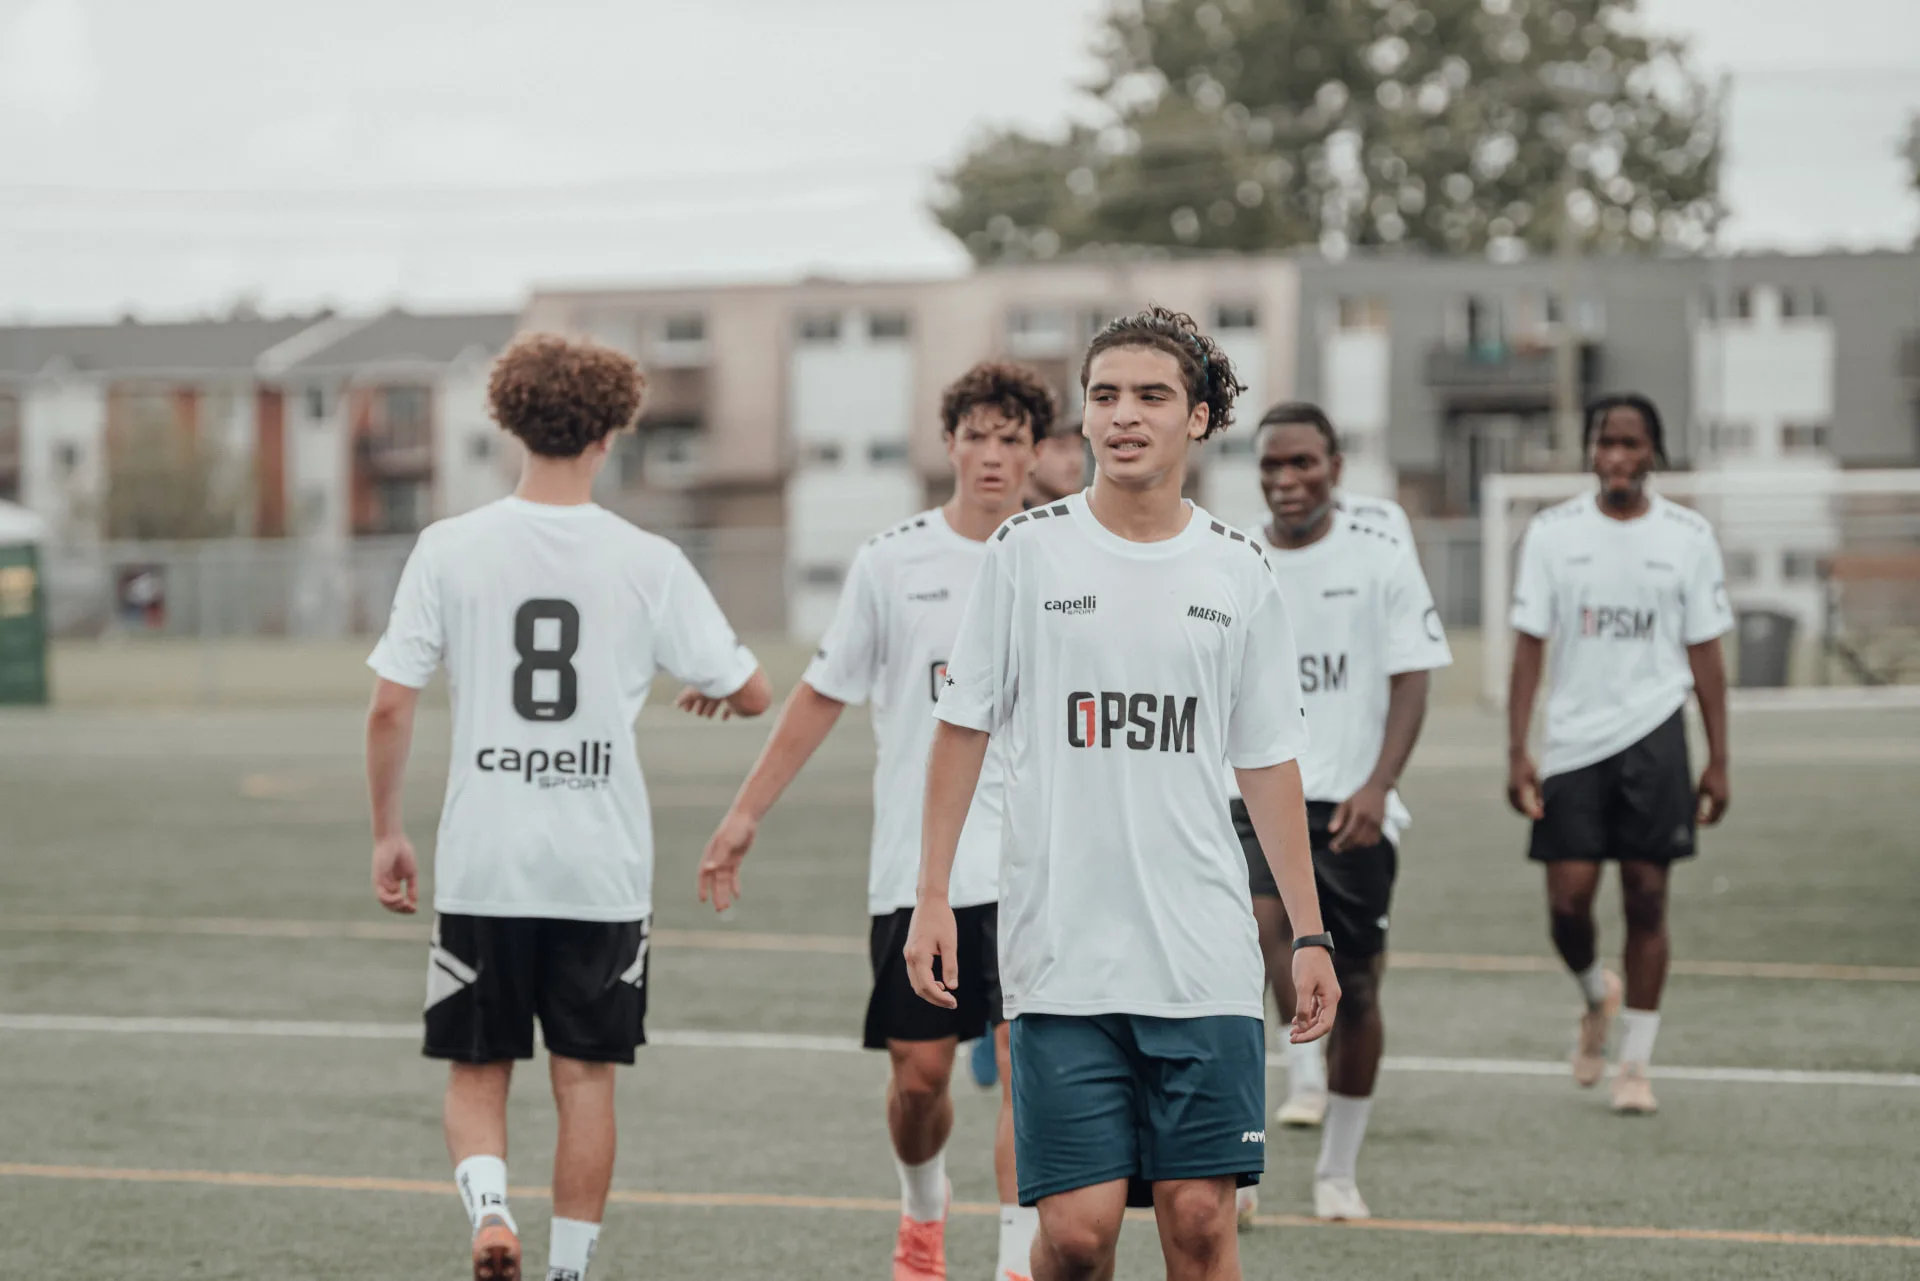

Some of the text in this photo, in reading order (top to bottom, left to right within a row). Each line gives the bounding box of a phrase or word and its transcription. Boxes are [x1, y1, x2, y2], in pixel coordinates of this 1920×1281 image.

[1044, 595, 1096, 613] capelli
[1187, 605, 1232, 628] MAESTRO
[513, 598, 579, 722] 8
[476, 740, 611, 783] capelli
